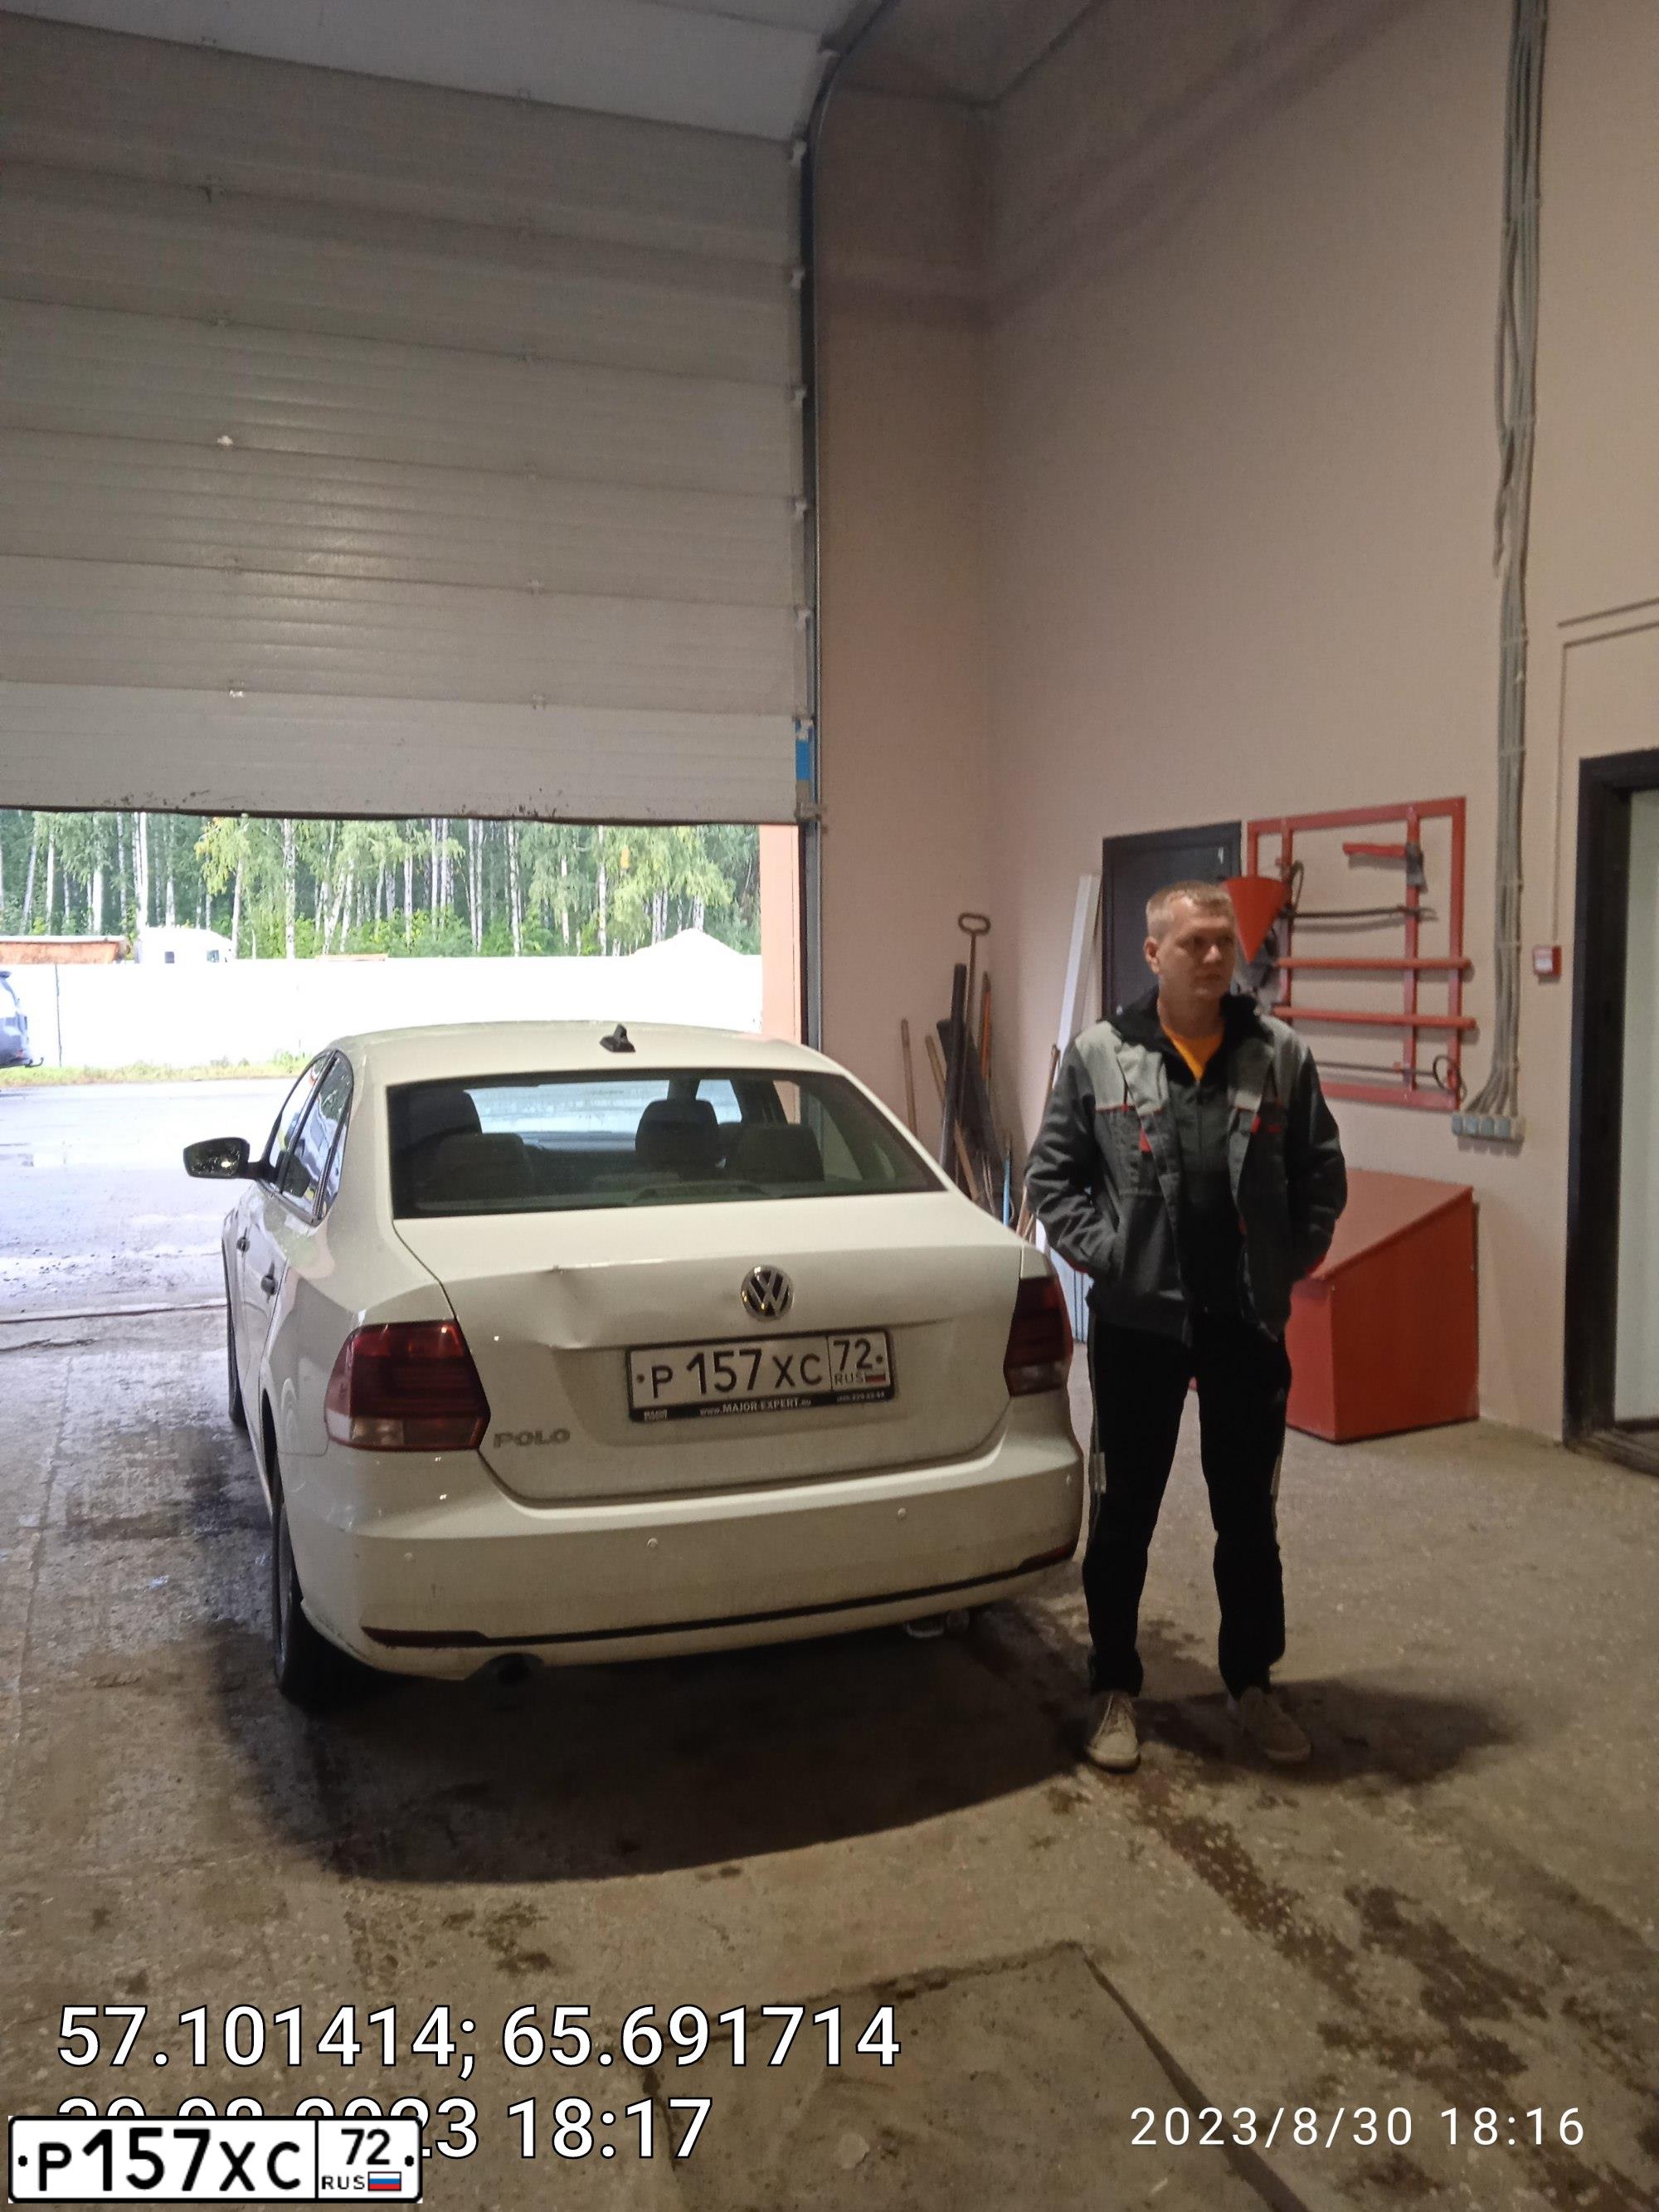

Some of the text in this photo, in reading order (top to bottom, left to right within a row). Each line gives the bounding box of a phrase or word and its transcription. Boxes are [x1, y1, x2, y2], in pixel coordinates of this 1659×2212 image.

[833, 1338, 873, 1371] 72
[834, 1372, 864, 1386] RUS
[493, 1429, 571, 1449] POLO
